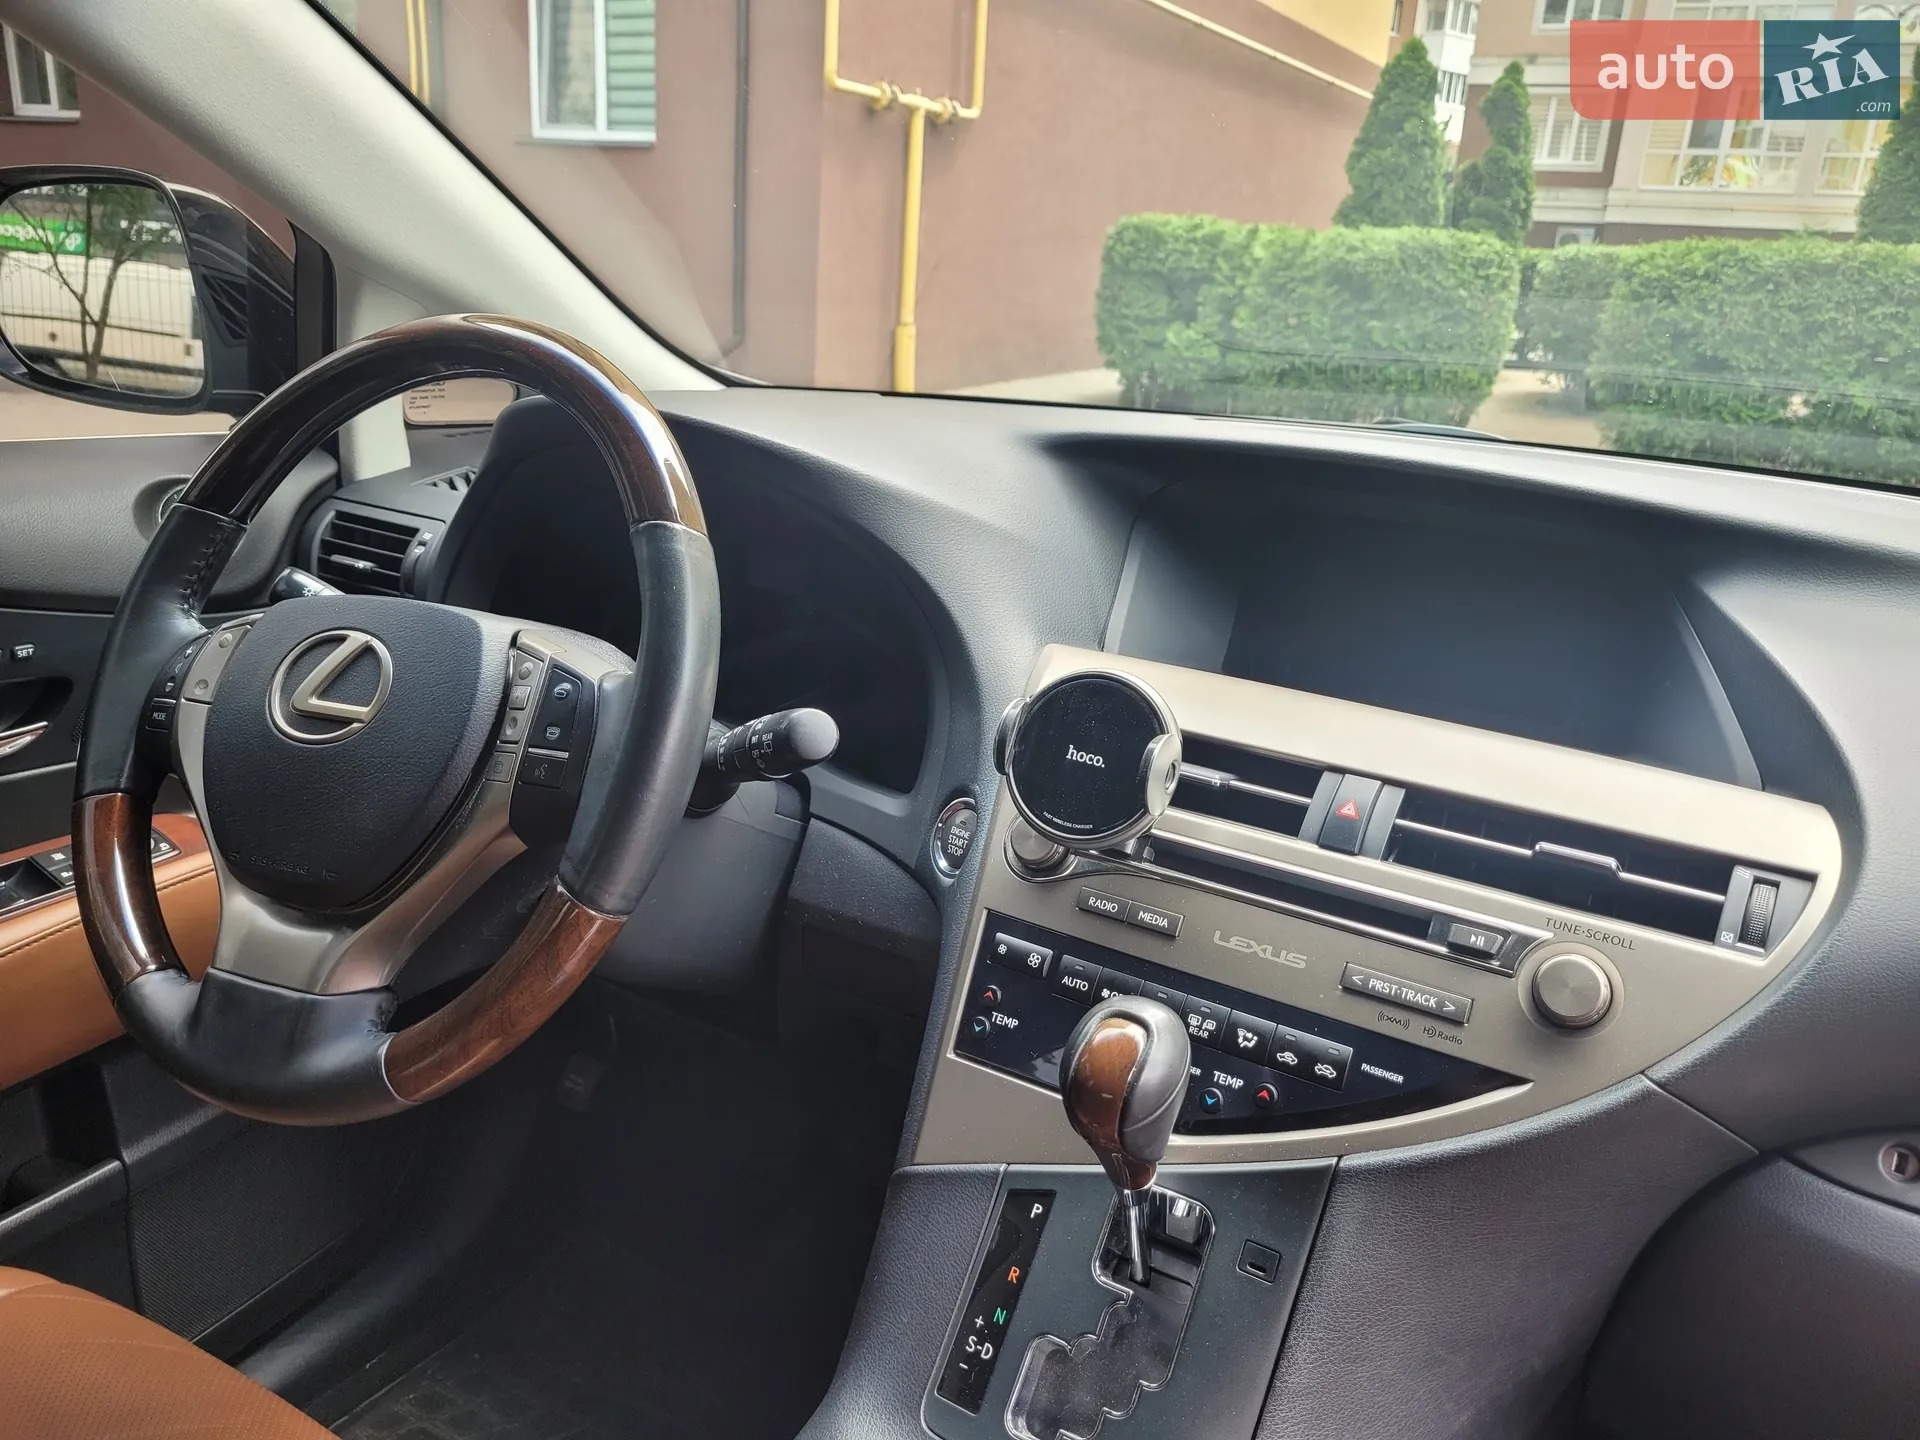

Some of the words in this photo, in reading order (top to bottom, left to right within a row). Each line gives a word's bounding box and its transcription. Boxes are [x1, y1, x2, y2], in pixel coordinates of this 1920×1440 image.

[17, 648, 34, 658] SET
[152, 711, 167, 721] MODE
[1065, 744, 1106, 768] hoco.
[950, 825, 972, 840] ENGINE
[948, 834, 968, 849] START
[947, 844, 964, 857] STOP
[1088, 896, 1118, 913] RADIO
[1137, 910, 1168, 928] MEDIA
[1213, 930, 1308, 969] LEXUS
[1061, 975, 1089, 991] AUTO
[991, 1011, 1019, 1029] TEMP
[1188, 1025, 1209, 1039] REAR
[1437, 1030, 1463, 1046] Radio
[1213, 1070, 1244, 1089] TEMP
[1361, 1062, 1404, 1083] PASSENGER
[1030, 1203, 1043, 1219] P
[1007, 1266, 1020, 1284] R
[993, 1306, 1007, 1325] N
